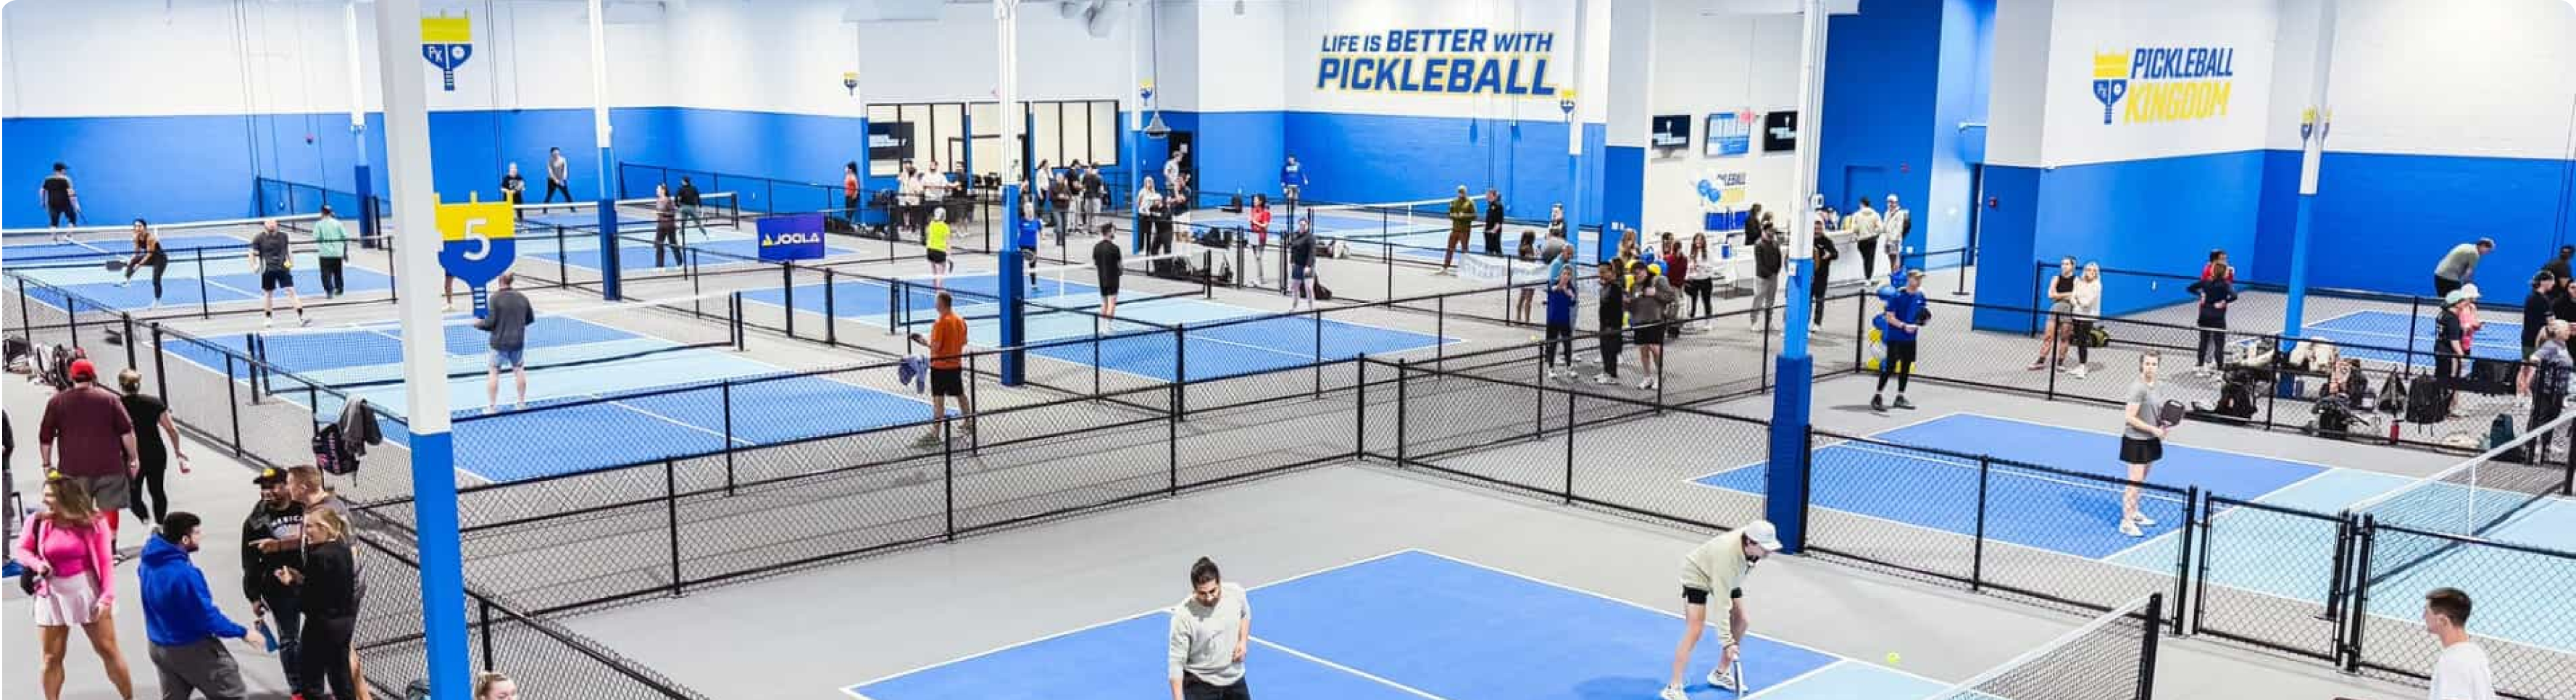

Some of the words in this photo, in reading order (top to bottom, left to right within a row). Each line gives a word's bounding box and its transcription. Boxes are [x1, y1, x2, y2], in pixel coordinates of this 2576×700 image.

[1322, 35, 1359, 52] LIFE
[1363, 35, 1382, 52] IS
[1386, 28, 1488, 52] BETTER
[1493, 33, 1554, 52] WITH
[1316, 57, 1556, 95] PICKLEBALL
[2130, 47, 2234, 79] PICKLEBALL
[2124, 81, 2232, 126] KINGDOM
[463, 218, 491, 261] 5
[774, 233, 821, 245] JOOLA
